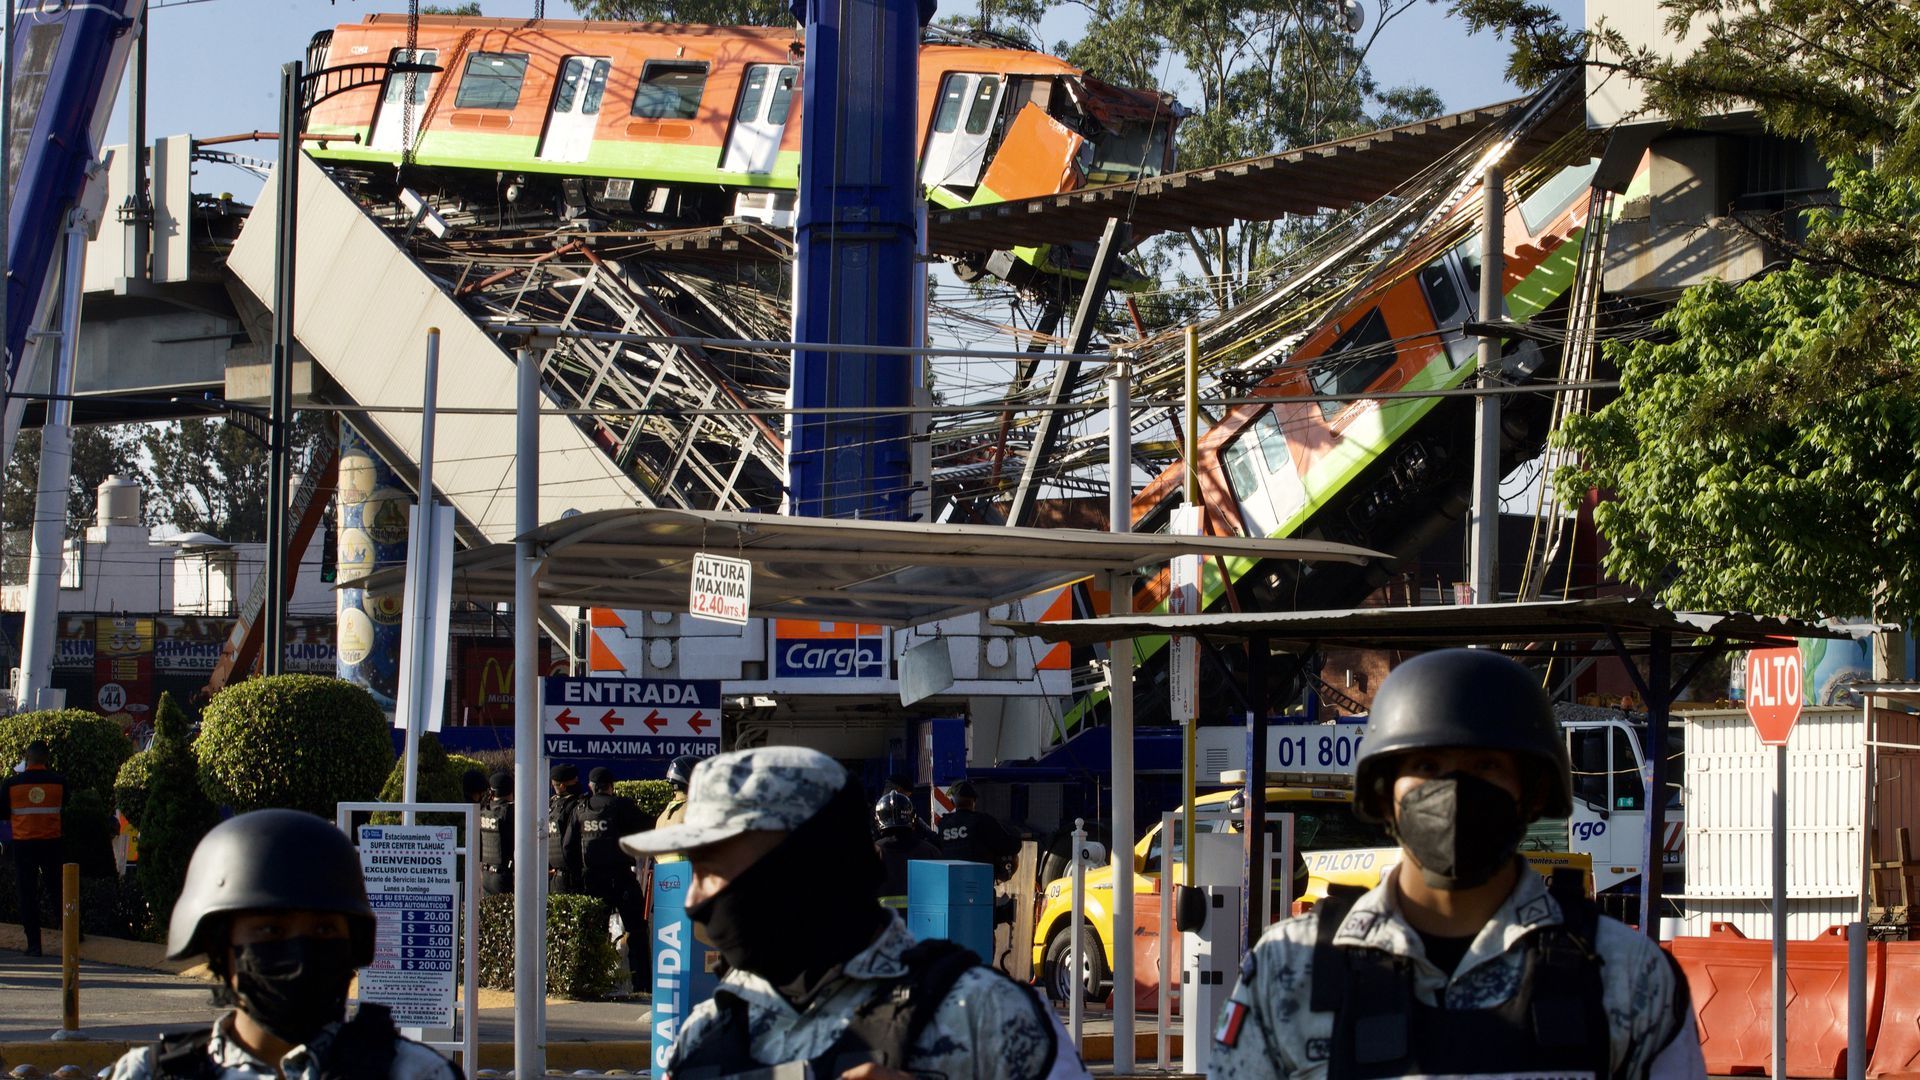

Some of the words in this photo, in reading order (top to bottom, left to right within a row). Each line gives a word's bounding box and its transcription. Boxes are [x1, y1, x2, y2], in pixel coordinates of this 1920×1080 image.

[697, 560, 745, 581] ALTURA
[695, 577, 745, 599] MAXIMA
[699, 593, 724, 615] 2.40
[723, 605, 741, 617] MTS.
[786, 643, 874, 675] Cargo
[1749, 655, 1799, 707] ALTO
[564, 681, 701, 704] ENTRADA
[547, 740, 582, 753] VEL.
[587, 741, 653, 754] MAXIMA
[657, 742, 676, 755] 10
[680, 742, 717, 755] K/HR
[1279, 736, 1306, 767] 01
[583, 819, 608, 832] SSC
[384, 832, 431, 841] Estacionamiento
[943, 825, 969, 841] SSC
[391, 842, 416, 850] CENTER
[371, 856, 442, 865] BIENVENIDOS
[1315, 853, 1375, 871] PILOTO
[364, 866, 408, 874] EXCLUSIVO
[410, 867, 448, 875] CLIENTES
[427, 876, 434, 884] 24
[406, 885, 430, 894] Domingo
[375, 901, 403, 909] CAJEROS
[407, 911, 415, 920] $
[424, 912, 450, 921] 20.00
[407, 923, 415, 932] $
[429, 924, 451, 933] 5.00
[407, 936, 415, 945] $
[429, 937, 450, 946] 5.00
[407, 948, 415, 957] $
[424, 949, 451, 958] 20.00
[407, 960, 415, 969] $
[418, 961, 451, 970] 200.00
[656, 920, 682, 1069] SALIDA
